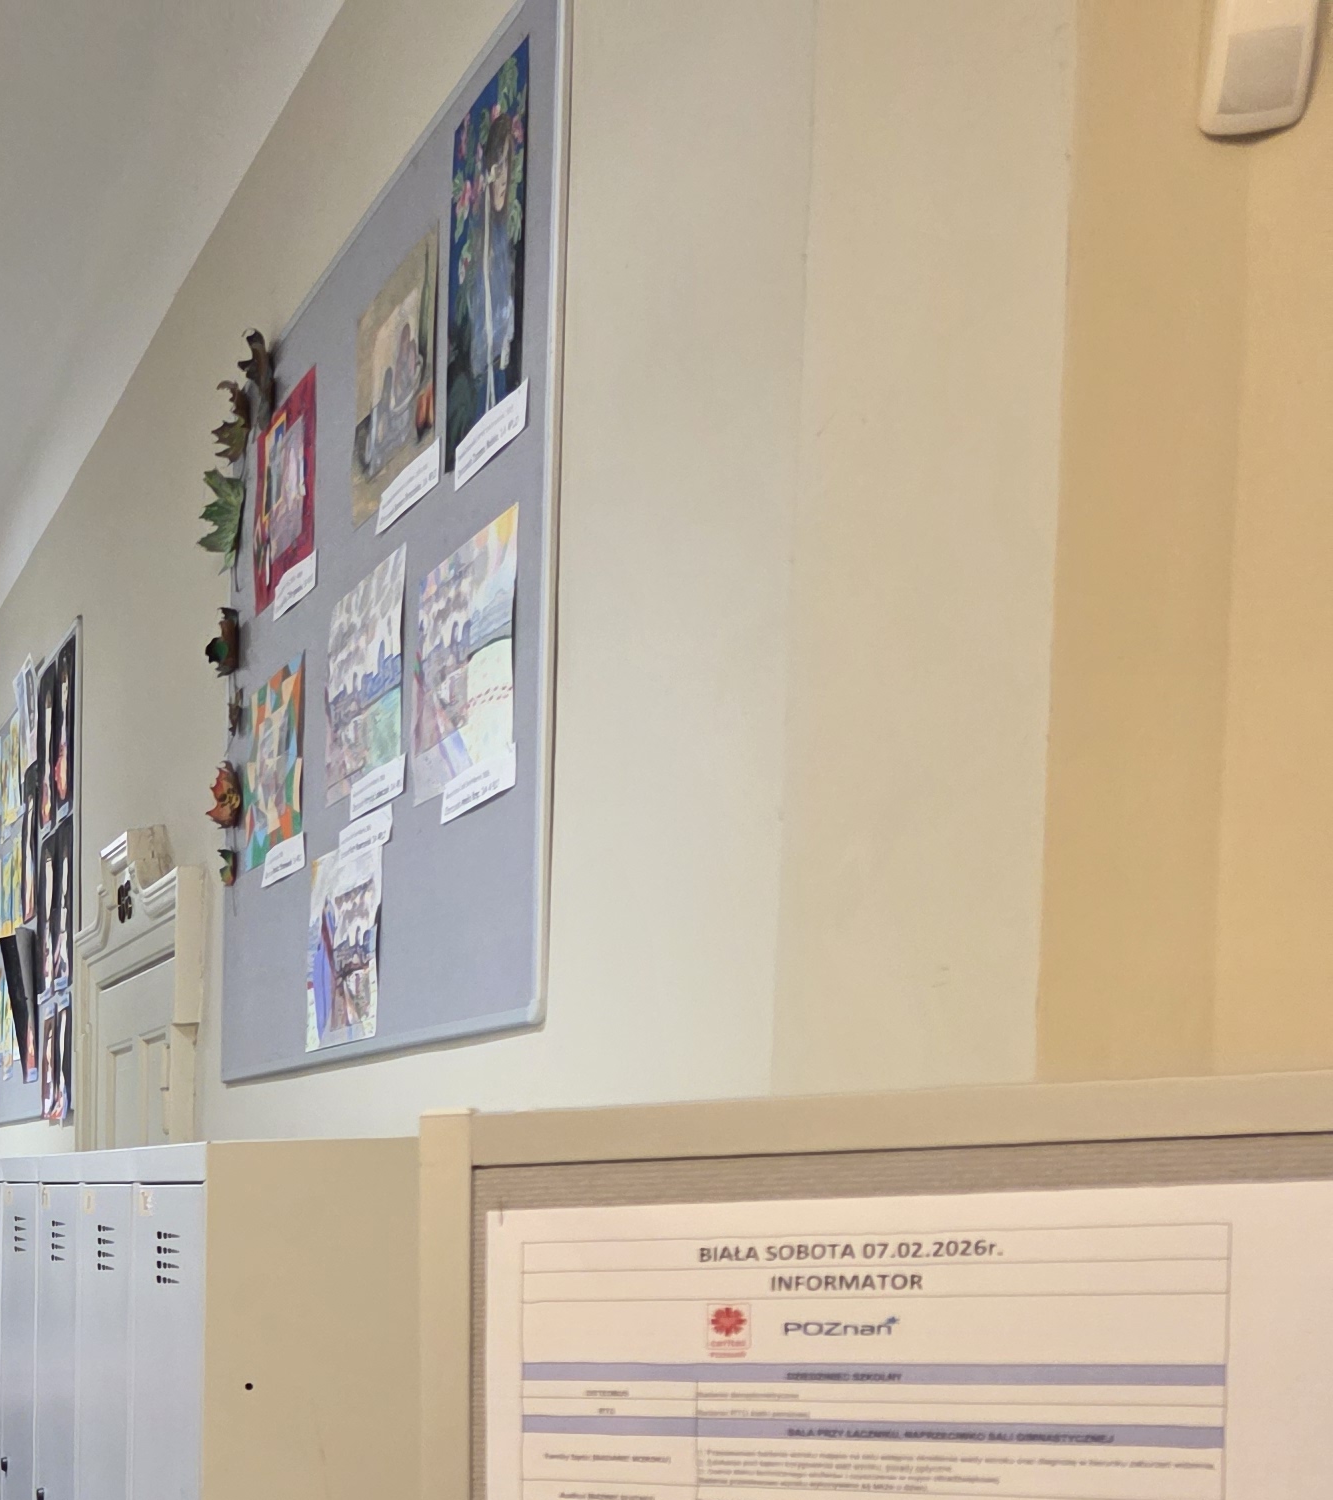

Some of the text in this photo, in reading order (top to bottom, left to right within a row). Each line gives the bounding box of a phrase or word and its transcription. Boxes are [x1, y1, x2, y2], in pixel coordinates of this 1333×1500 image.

[698, 1239, 1004, 1263] BIAŁA SOBOTA 07.02.2026r.
[770, 1272, 923, 1293] INFORMATOR
